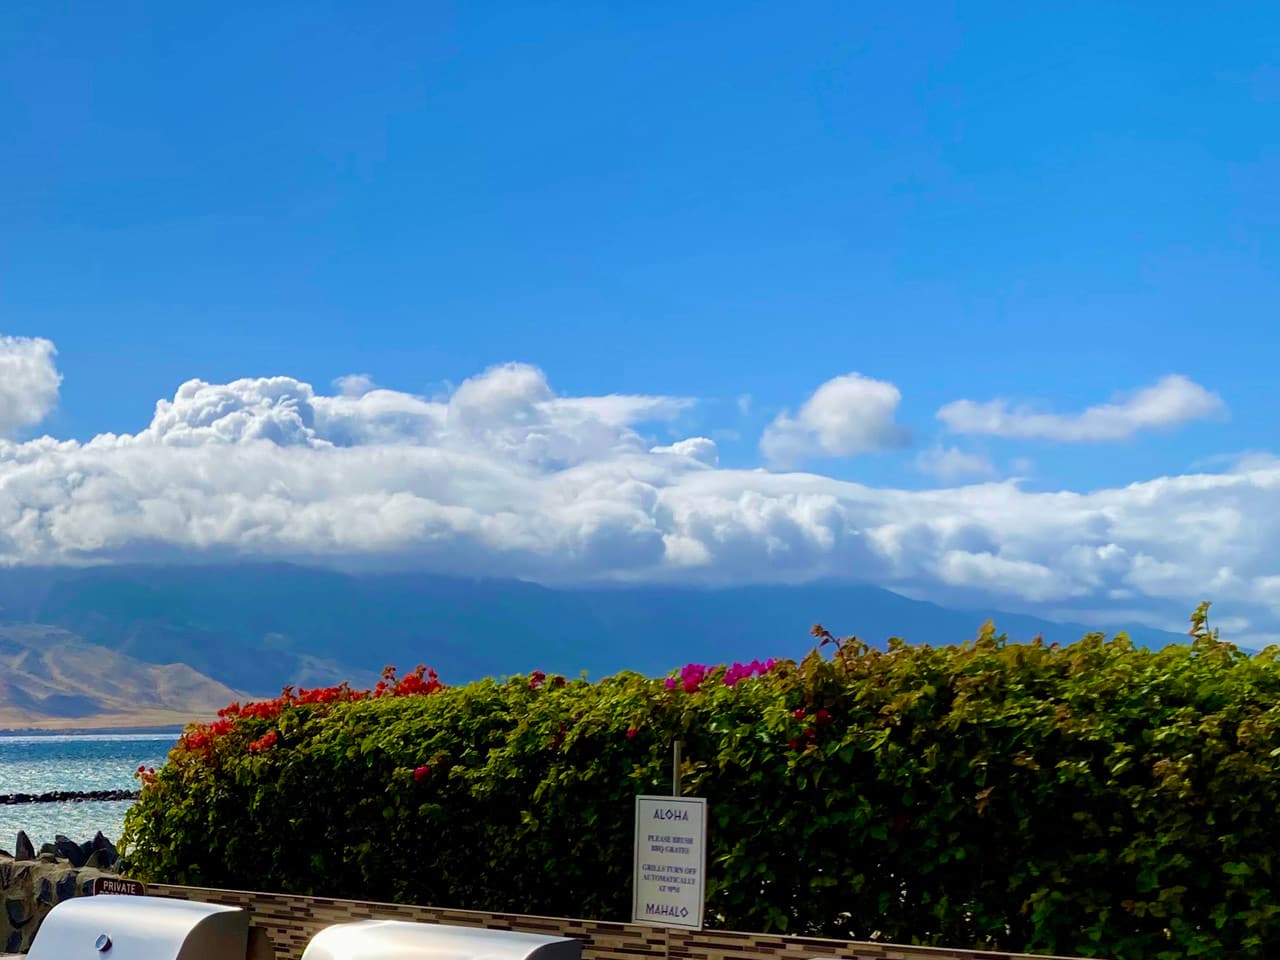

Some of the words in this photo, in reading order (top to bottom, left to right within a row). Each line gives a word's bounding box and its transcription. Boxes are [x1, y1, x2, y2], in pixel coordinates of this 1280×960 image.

[653, 809, 689, 821] ALOHA
[648, 835, 671, 843] PLEASE
[651, 845, 664, 853] BBQ
[642, 864, 665, 872] GRILLS
[684, 867, 696, 875] OFF
[643, 874, 696, 885] AUTOMATICALLY
[103, 880, 136, 894] PRIVATE
[645, 903, 689, 918] MAHALO
